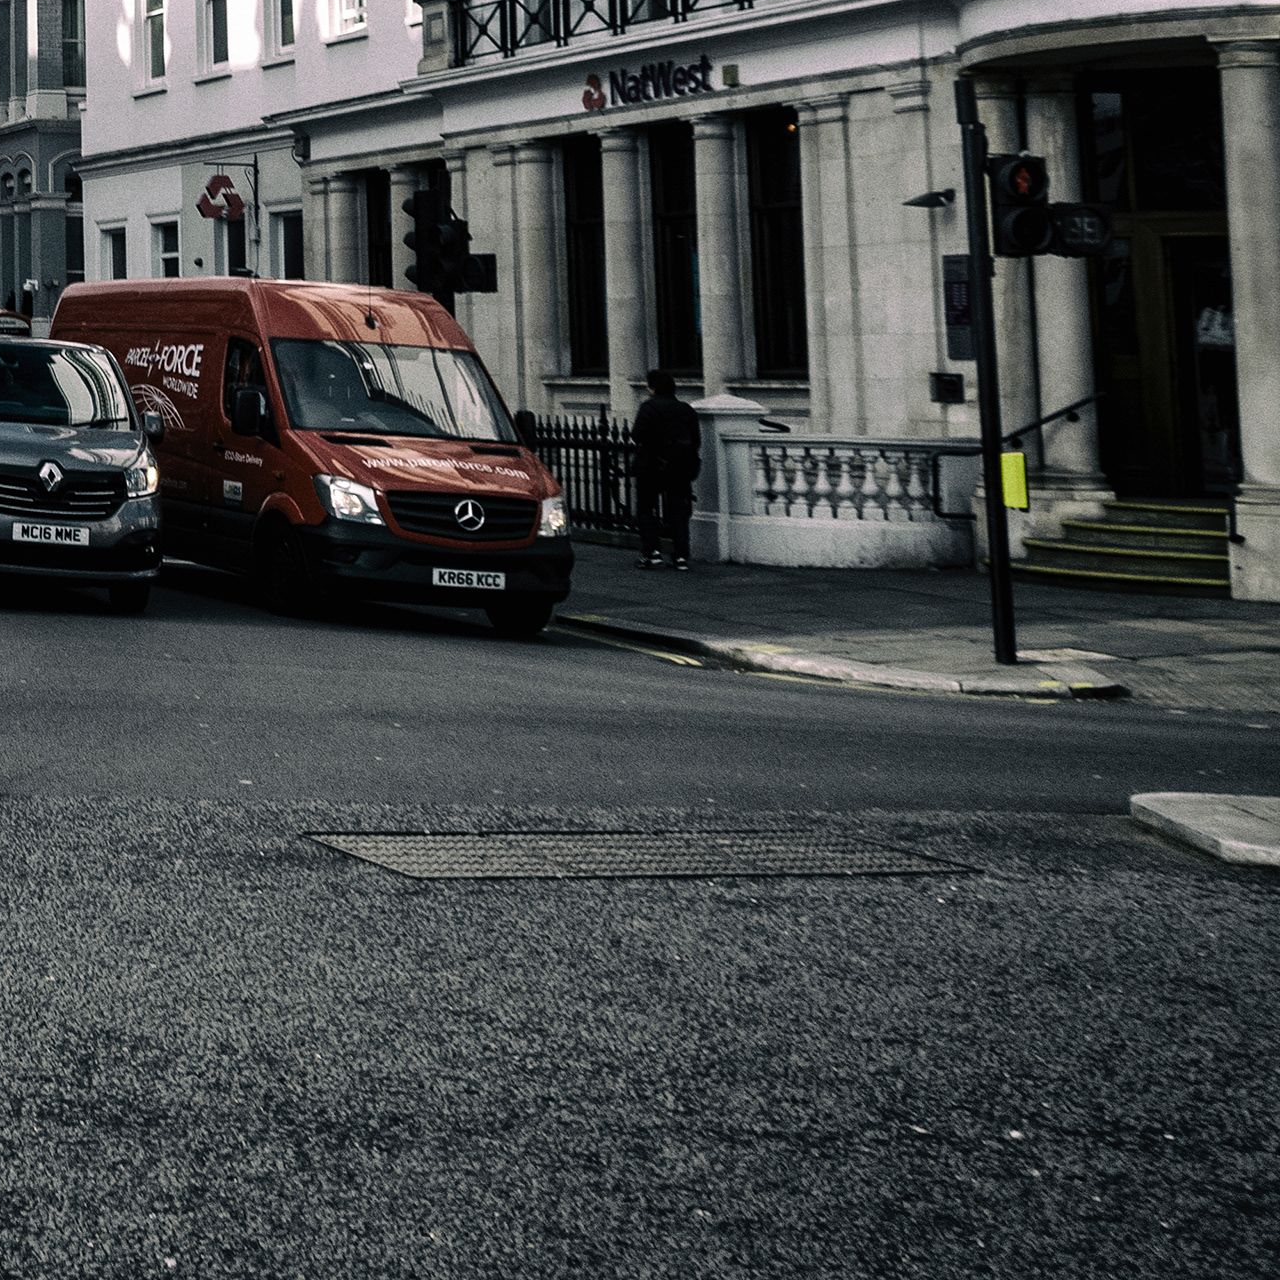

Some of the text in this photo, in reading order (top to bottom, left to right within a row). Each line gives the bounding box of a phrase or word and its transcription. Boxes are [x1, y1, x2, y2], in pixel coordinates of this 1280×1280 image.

[609, 53, 713, 106] NatWest
[125, 343, 205, 378] PARCEL FORCE
[162, 375, 199, 400] WORLDWIDE
[362, 457, 531, 481] www.parcelforce.com
[21, 524, 52, 540] MC16
[438, 571, 501, 588] KR66 KCC
